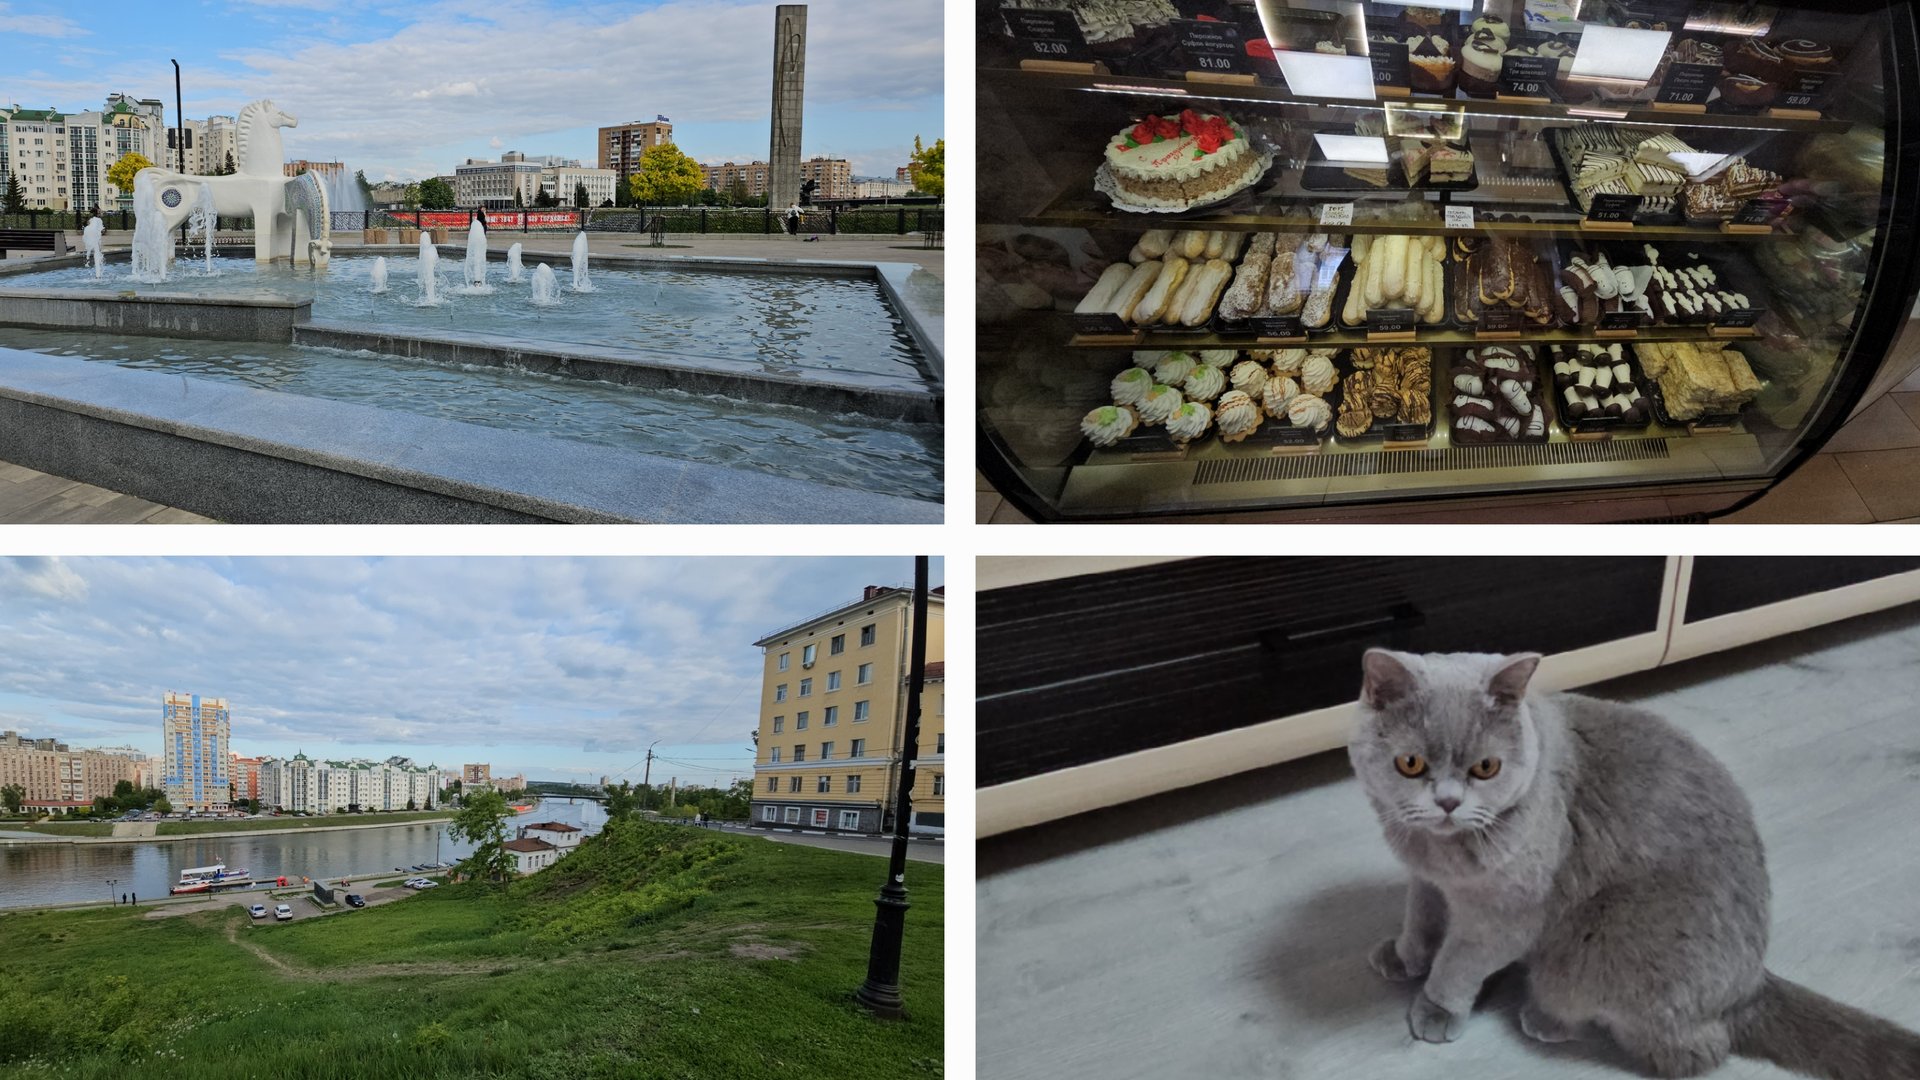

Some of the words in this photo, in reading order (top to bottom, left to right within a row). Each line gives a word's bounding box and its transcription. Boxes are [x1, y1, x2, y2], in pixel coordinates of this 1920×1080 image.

[1189, 32, 1223, 41] Пирожное
[1033, 42, 1068, 54] 82.00
[1199, 57, 1231, 69] 81.00
[1512, 82, 1539, 92] 74.00
[1669, 92, 1694, 102] 71.00
